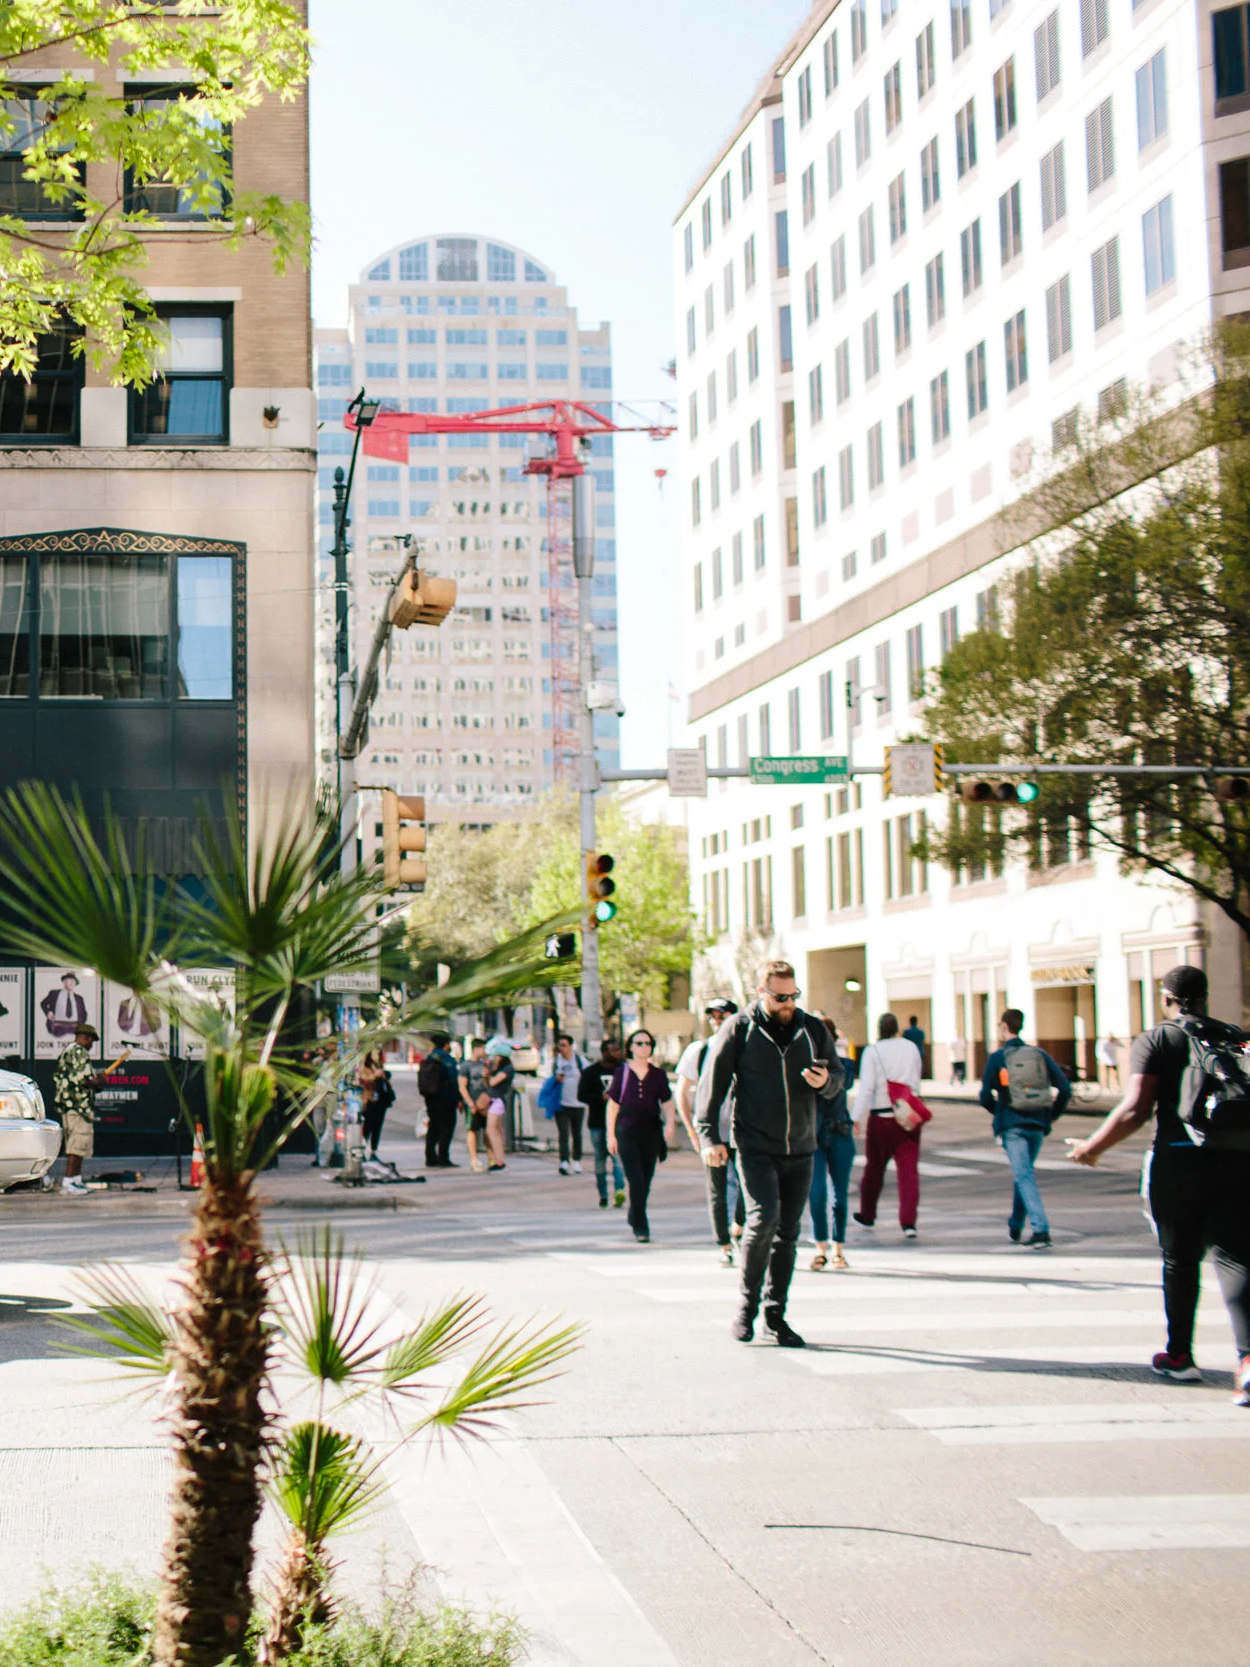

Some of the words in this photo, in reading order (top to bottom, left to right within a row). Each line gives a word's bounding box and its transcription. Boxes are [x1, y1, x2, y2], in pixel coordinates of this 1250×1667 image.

[754, 758, 819, 775] Congress
[824, 757, 844, 767] AVE
[186, 975, 209, 985] RUN
